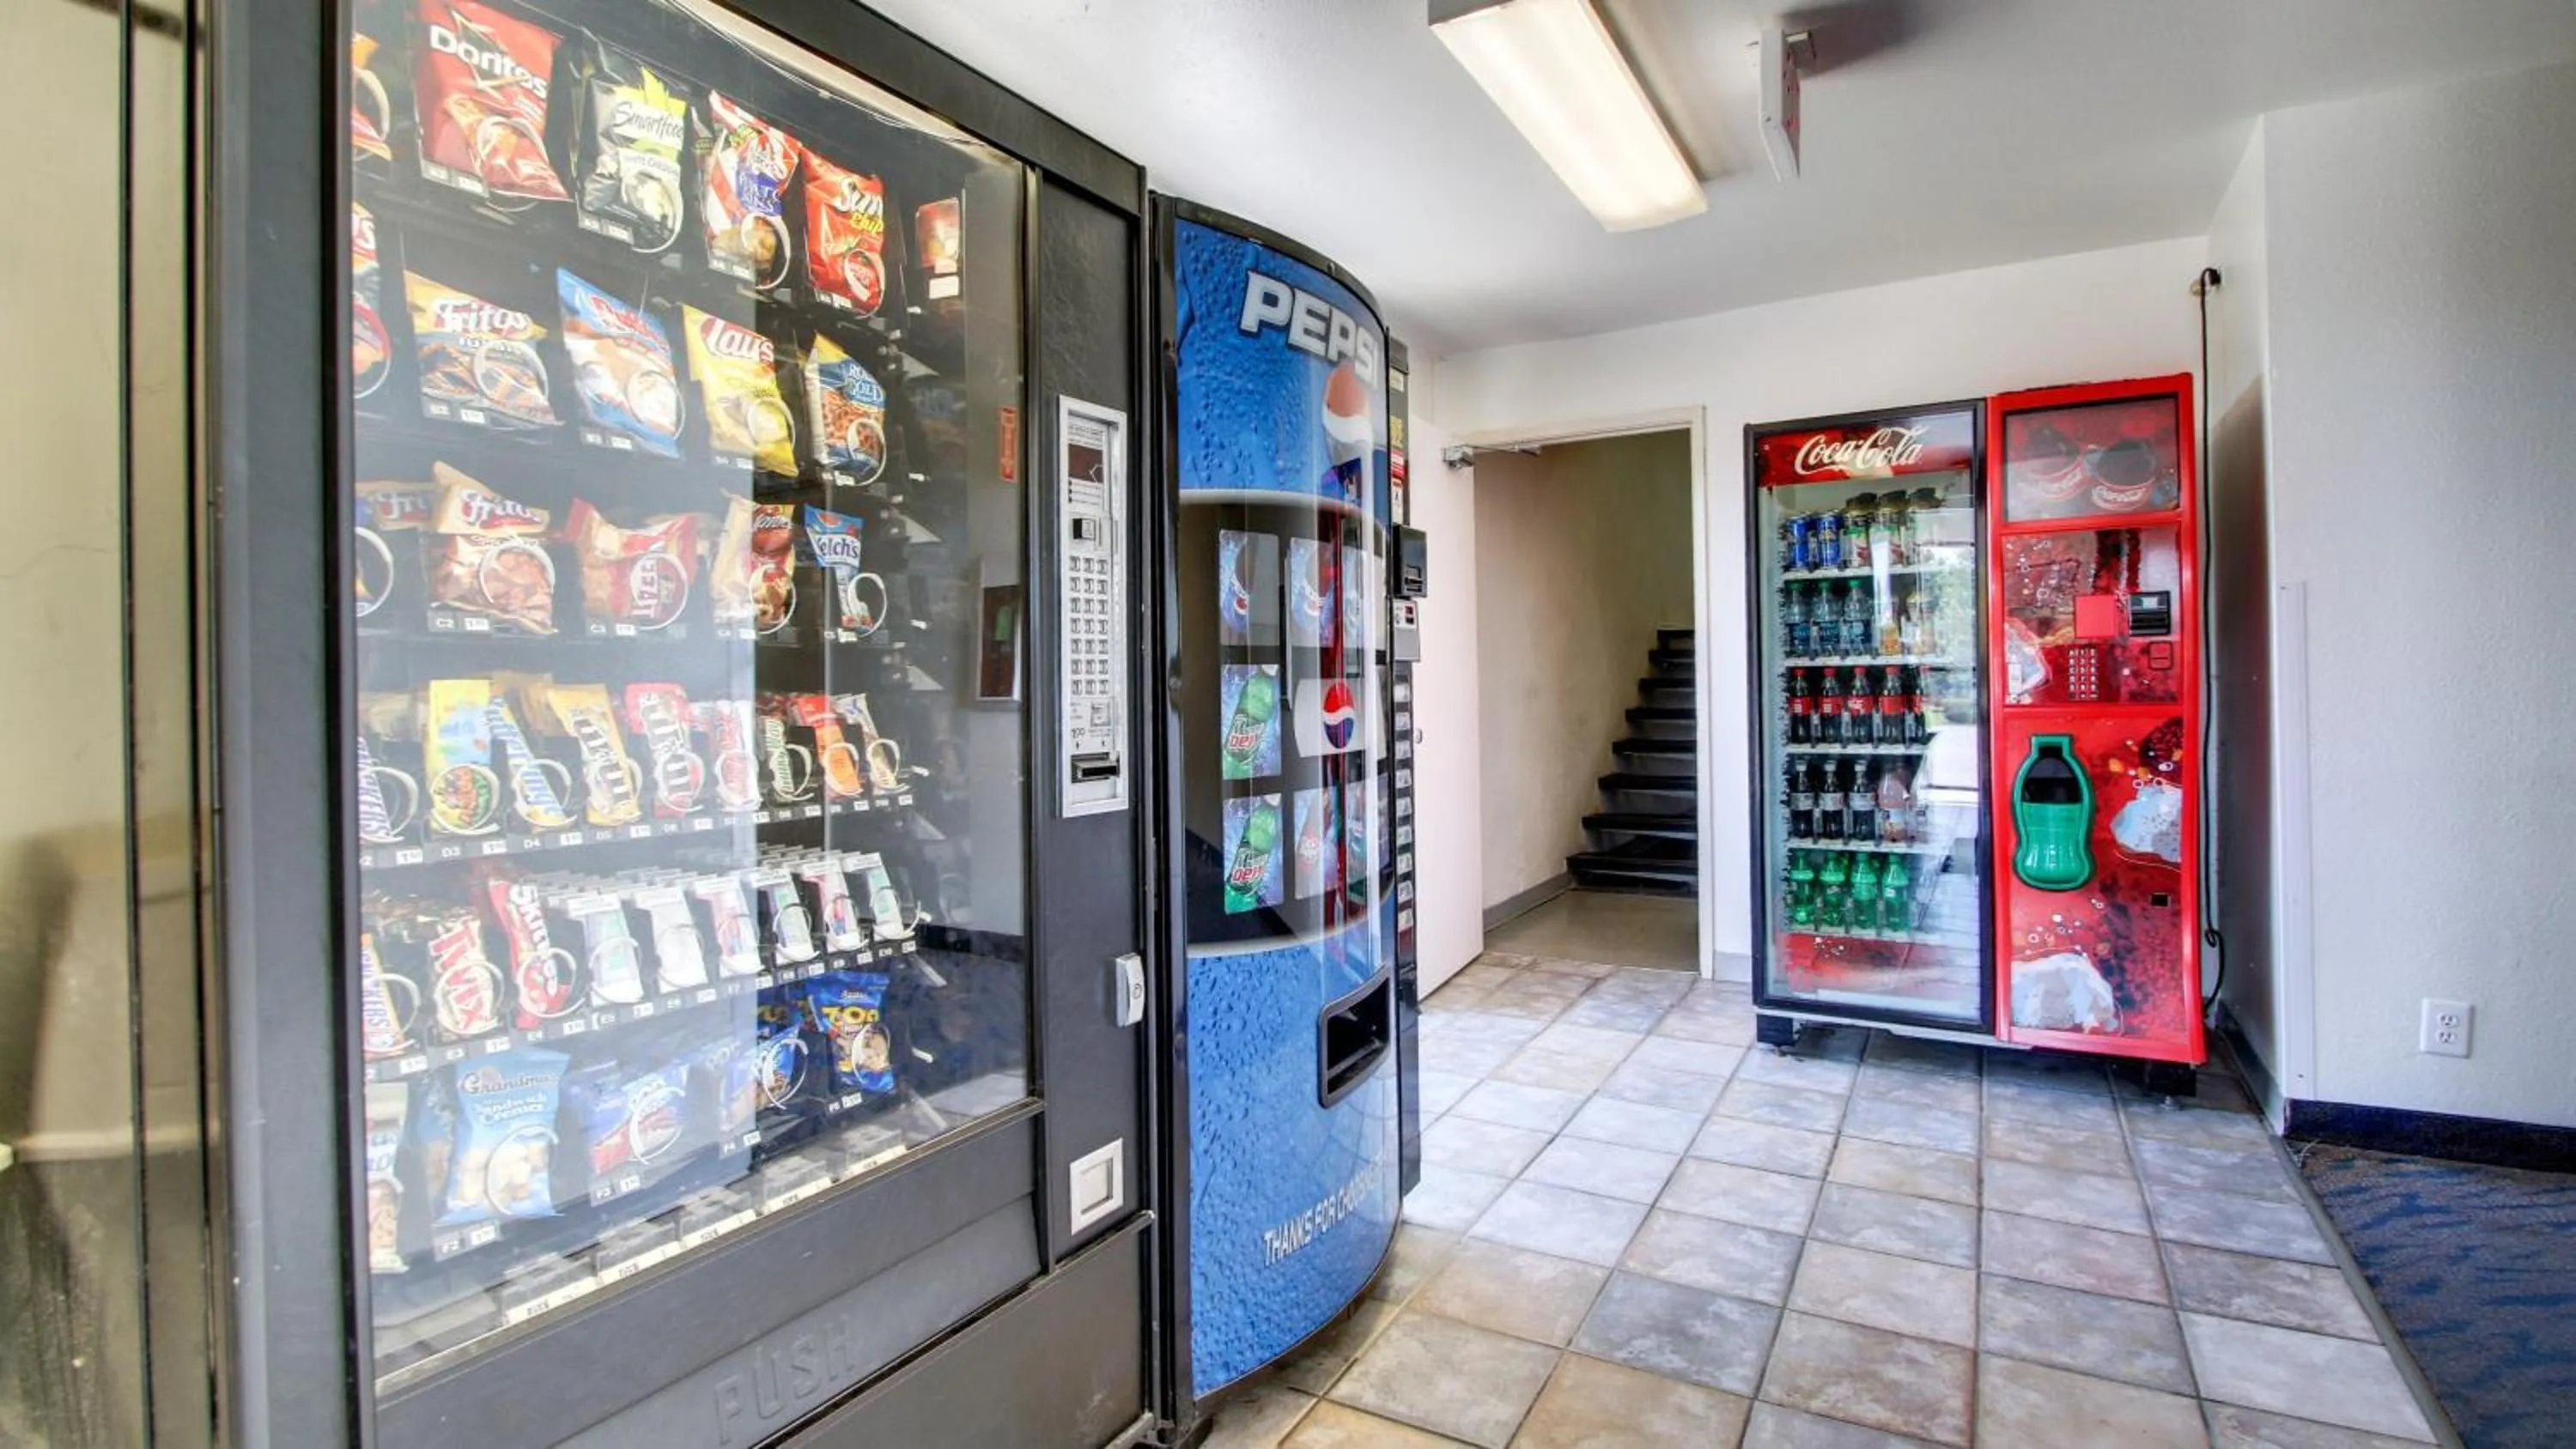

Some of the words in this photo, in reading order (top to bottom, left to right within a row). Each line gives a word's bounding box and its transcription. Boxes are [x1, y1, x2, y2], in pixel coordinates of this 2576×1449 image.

[430, 24, 548, 100] Doritos
[1795, 426, 1931, 476] Coca-Cola
[523, 838, 541, 849] D4
[1264, 1208, 1313, 1267] THANKS
[714, 1314, 854, 1446] PUSH
